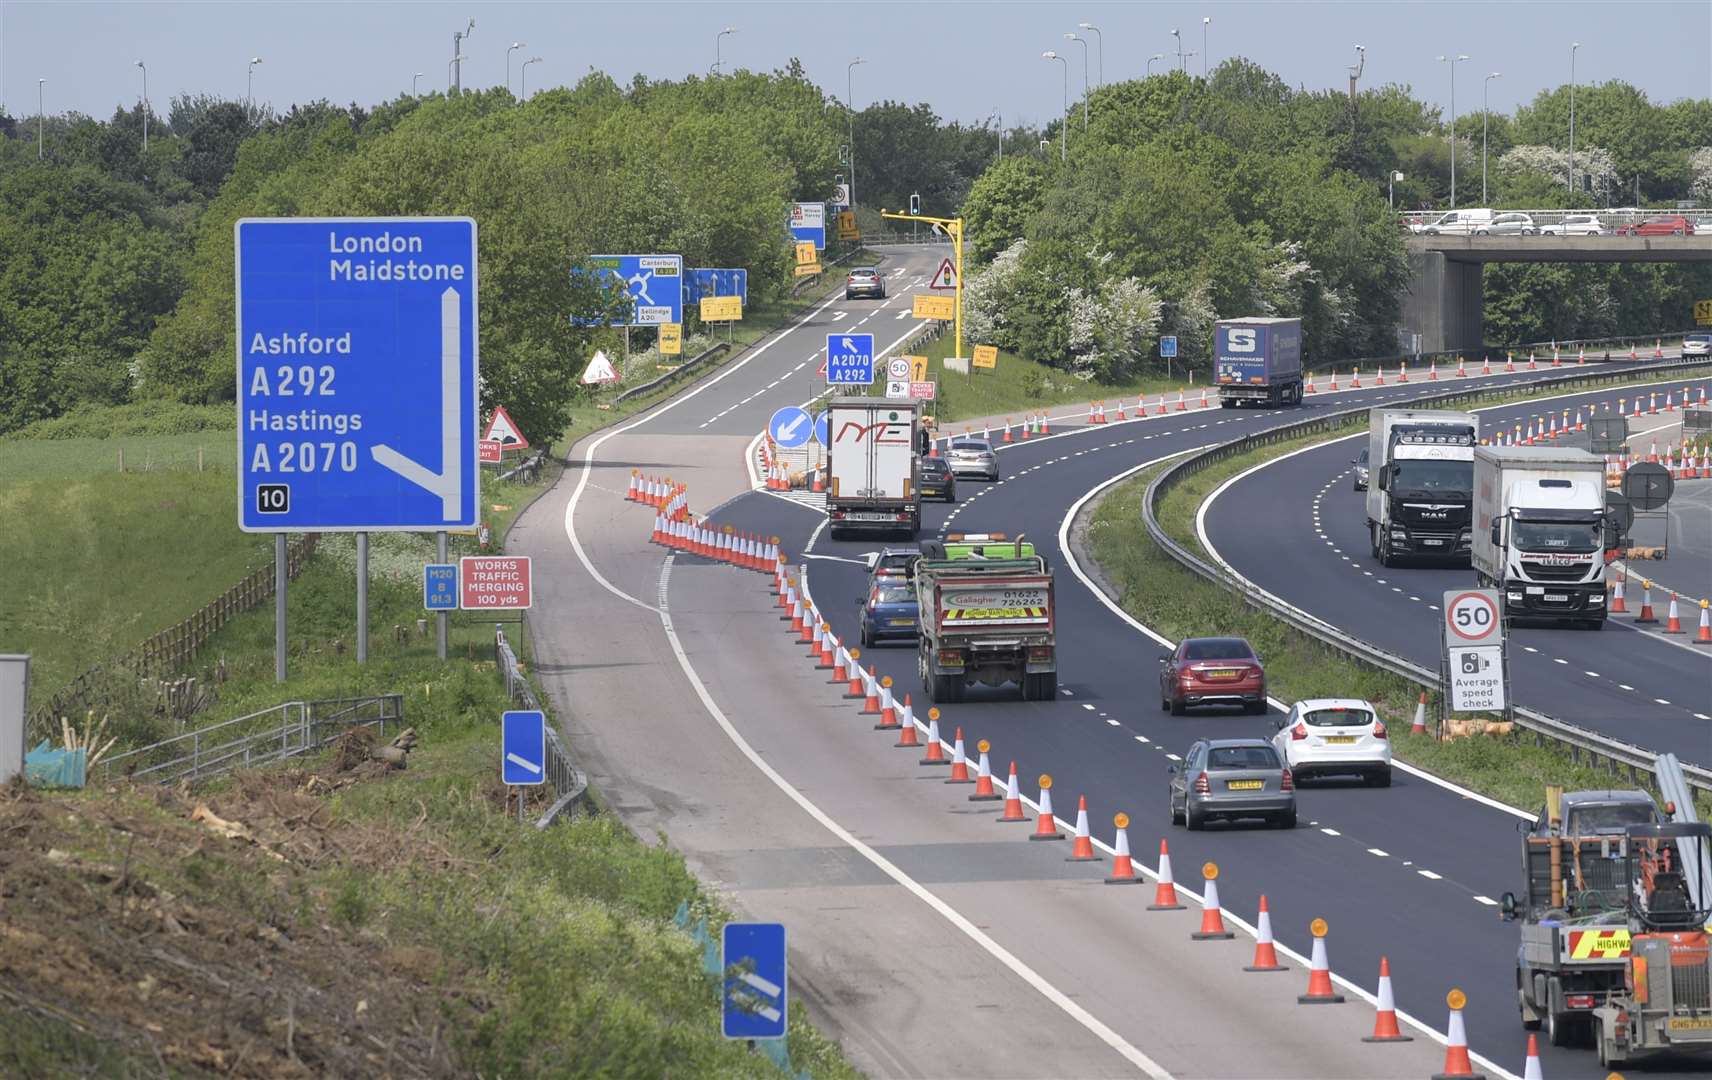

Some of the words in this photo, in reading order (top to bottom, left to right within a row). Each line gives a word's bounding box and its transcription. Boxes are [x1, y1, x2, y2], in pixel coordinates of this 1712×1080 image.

[330, 231, 422, 253] London
[641, 259, 677, 268] Canterbury
[330, 259, 465, 281] Maidstone
[250, 332, 351, 354] Ashford
[1228, 329, 1256, 352] S
[893, 364, 907, 373] 50
[250, 409, 362, 435] Hastings
[261, 489, 285, 508] 10
[474, 561, 517, 570] WORKS
[430, 569, 453, 579] M20
[472, 571, 519, 581] TRAFFIC
[468, 582, 525, 592] MERGING
[478, 595, 497, 604] 100
[500, 594, 519, 606] yds
[1457, 607, 1490, 626] 50
[1455, 678, 1499, 688] Average
[1462, 688, 1493, 698] speed
[1463, 698, 1494, 708] check
[1597, 939, 1632, 949] HIGHWA
